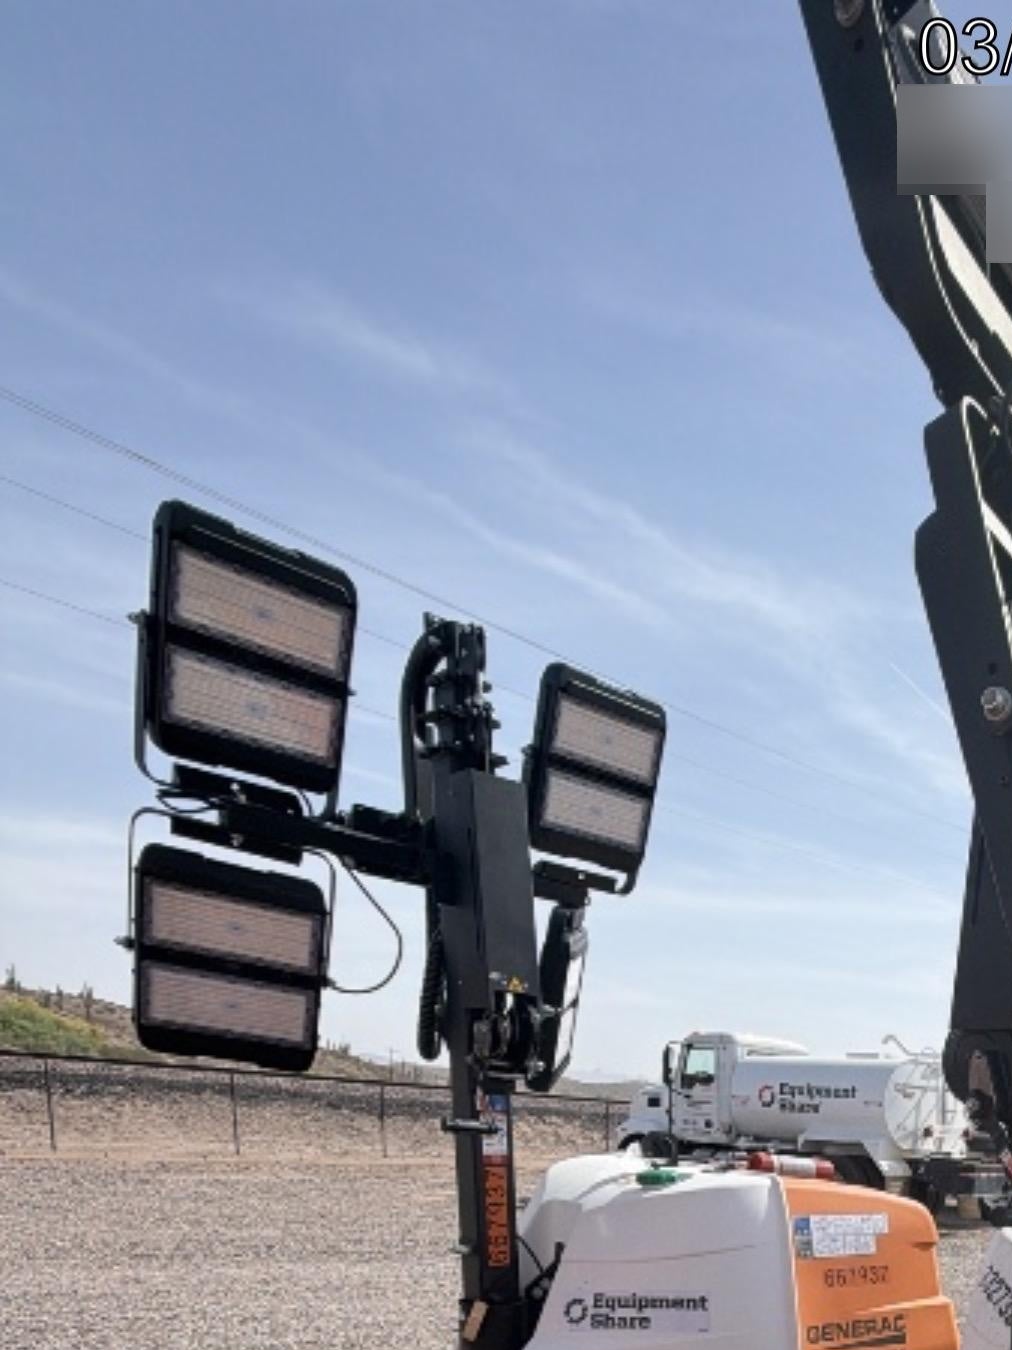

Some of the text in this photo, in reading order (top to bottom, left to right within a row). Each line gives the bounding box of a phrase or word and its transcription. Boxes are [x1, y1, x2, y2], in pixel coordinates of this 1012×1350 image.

[592, 1292, 709, 1312] Equipment
[590, 1314, 651, 1330] Share
[806, 1313, 906, 1344] GENERAC
